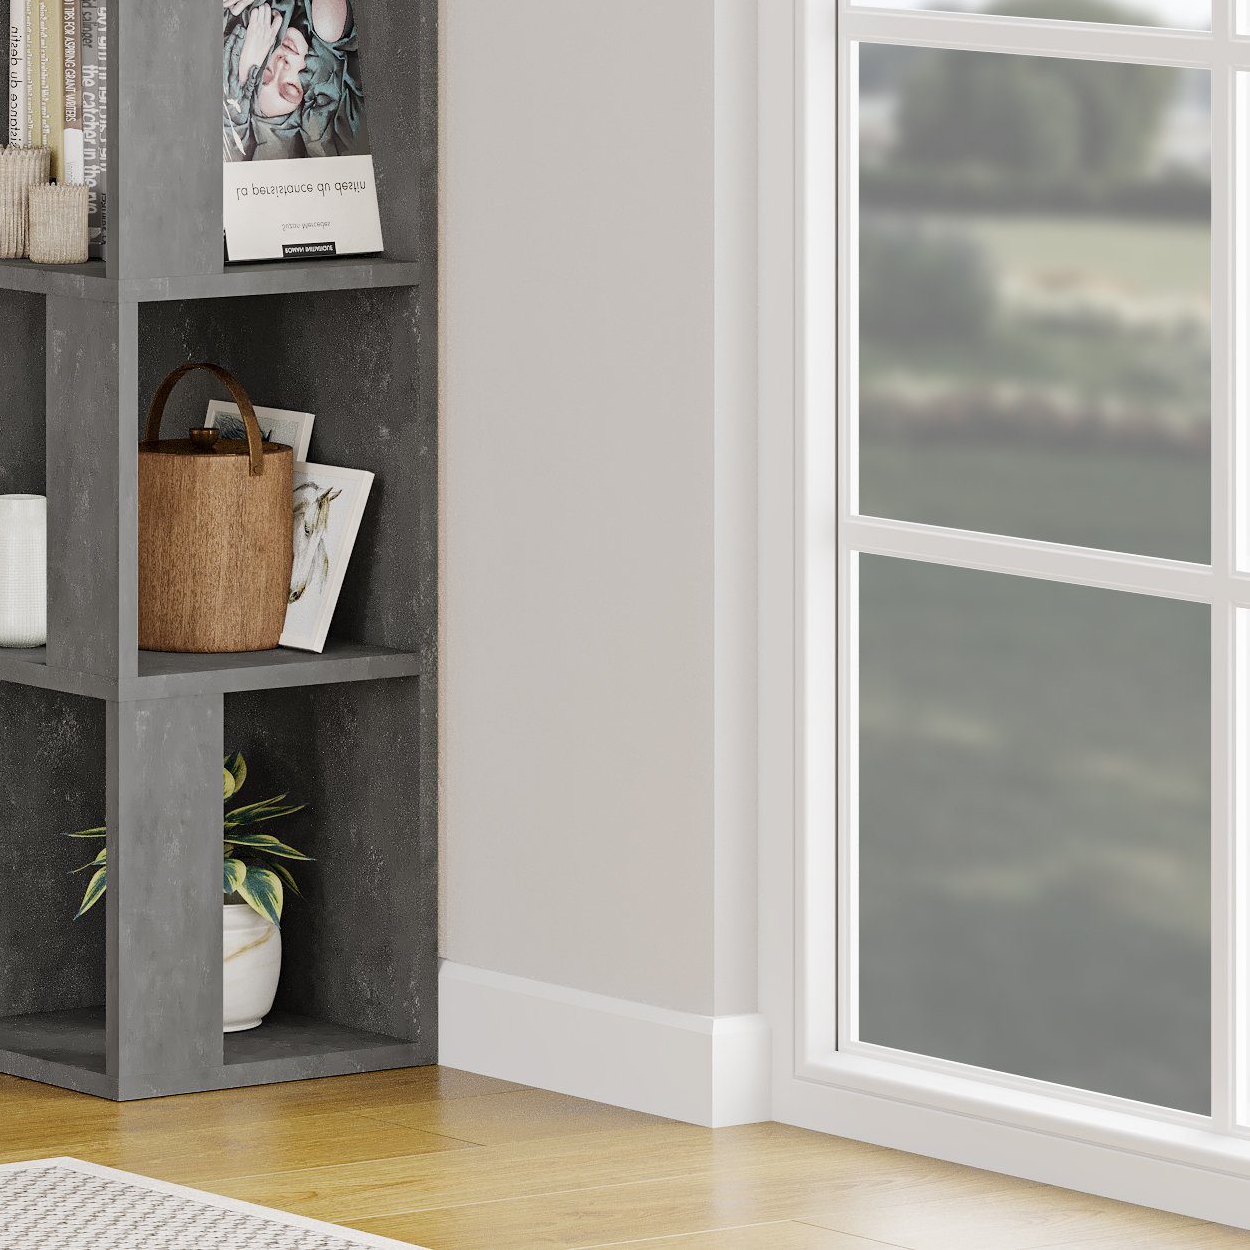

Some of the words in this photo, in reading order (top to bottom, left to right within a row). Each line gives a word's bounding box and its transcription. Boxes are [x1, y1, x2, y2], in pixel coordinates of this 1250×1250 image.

[63, 7, 75, 20] TIPS
[64, 21, 75, 35] FOR
[81, 11, 98, 49] salinger
[64, 36, 76, 68] ASPIRING
[64, 68, 76, 93] GRANT
[81, 65, 99, 87] the
[64, 93, 76, 123] WRITERS
[82, 91, 100, 145] catcher
[83, 148, 97, 160] in
[83, 164, 101, 188] the
